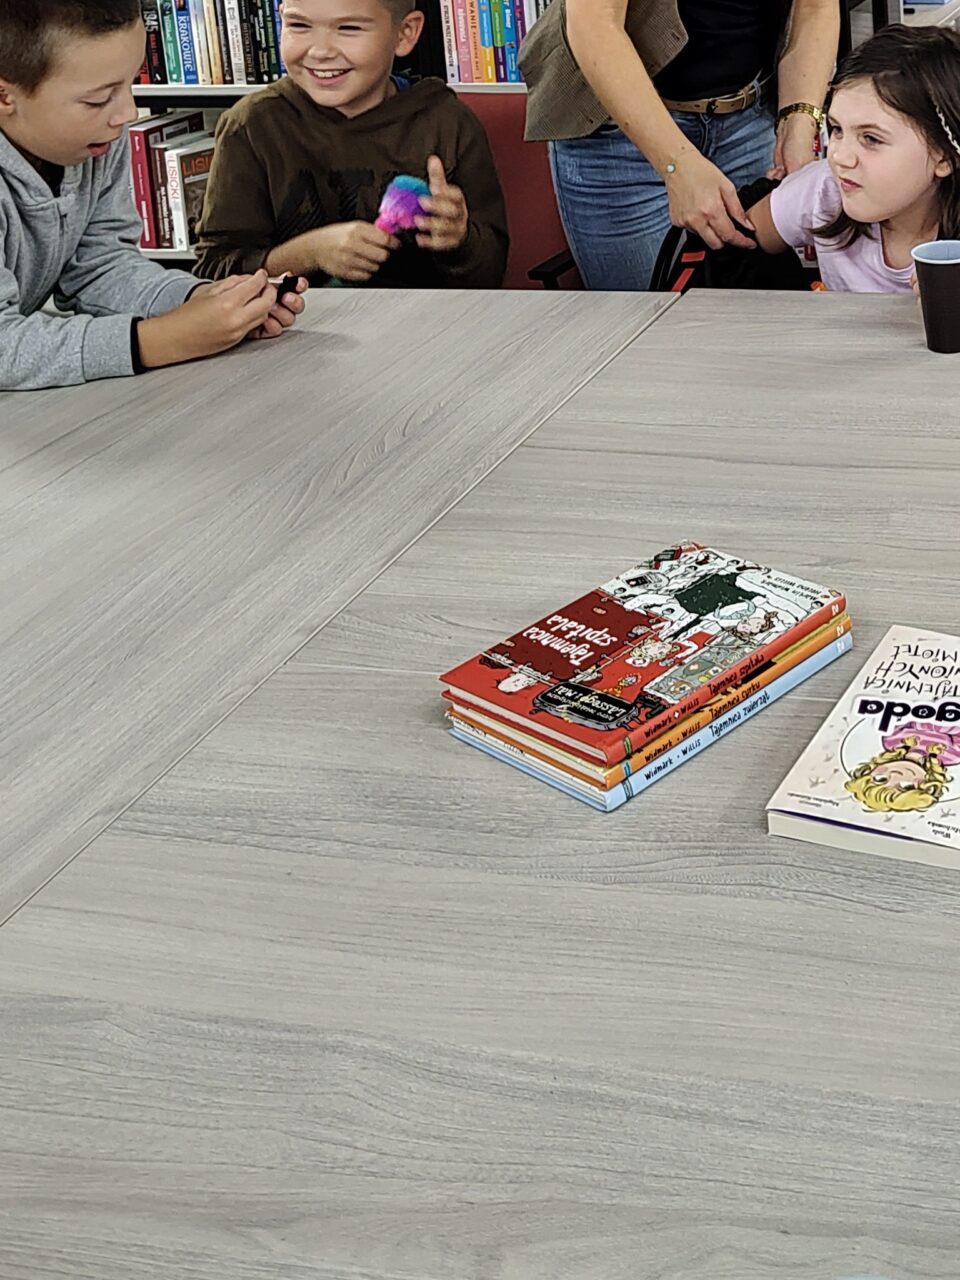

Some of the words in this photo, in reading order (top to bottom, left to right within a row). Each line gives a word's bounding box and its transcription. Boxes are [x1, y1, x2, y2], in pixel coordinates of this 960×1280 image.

[144, 9, 159, 32] 1945
[178, 16, 194, 72] KRAKOWIE
[167, 159, 180, 200] LISICKI
[182, 157, 209, 177] LISI
[522, 624, 595, 667] Tajemnica
[545, 613, 619, 647] szpitala
[889, 644, 958, 663] MIOTEŁ
[643, 716, 672, 739] Widmark
[706, 671, 741, 696] Tajemnica
[741, 654, 764, 676] szpitala
[863, 676, 960, 699] TAJEMNICA
[644, 741, 672, 764] Widmark
[708, 695, 740, 719] Tajemnica
[741, 680, 760, 700] cyrku
[644, 758, 672, 781] Widmark
[708, 712, 741, 738] Tajemnica
[743, 690, 770, 717] zwierząt
